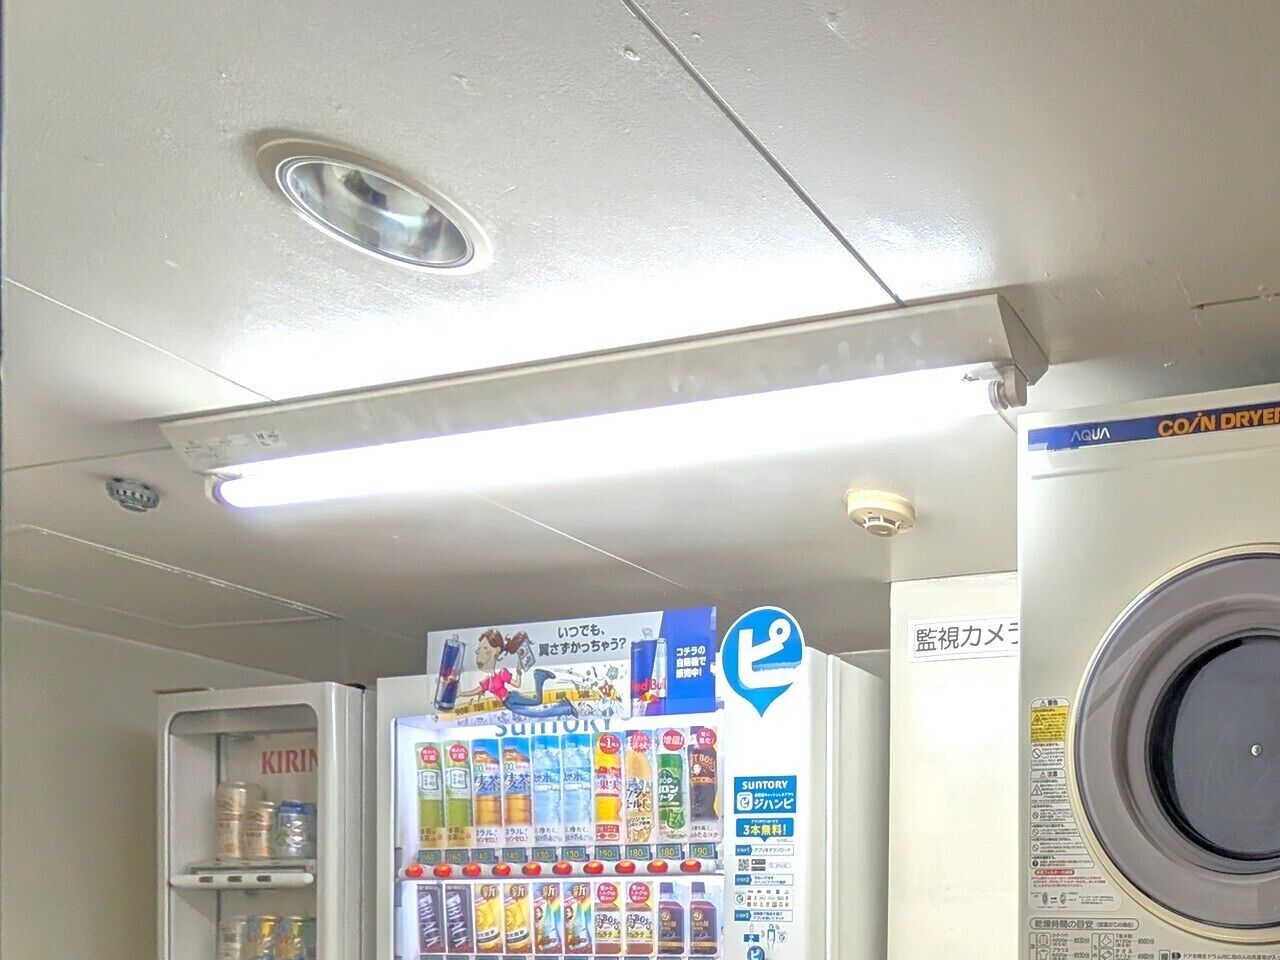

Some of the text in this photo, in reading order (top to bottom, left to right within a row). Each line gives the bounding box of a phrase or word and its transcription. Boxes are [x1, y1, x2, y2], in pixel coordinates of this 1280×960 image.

[1070, 427, 1111, 441] AQUA
[558, 624, 605, 639] いつでも、
[675, 645, 706, 656] コチラの
[742, 780, 789, 790] SUNTORY
[743, 824, 787, 836] 3本無料!
